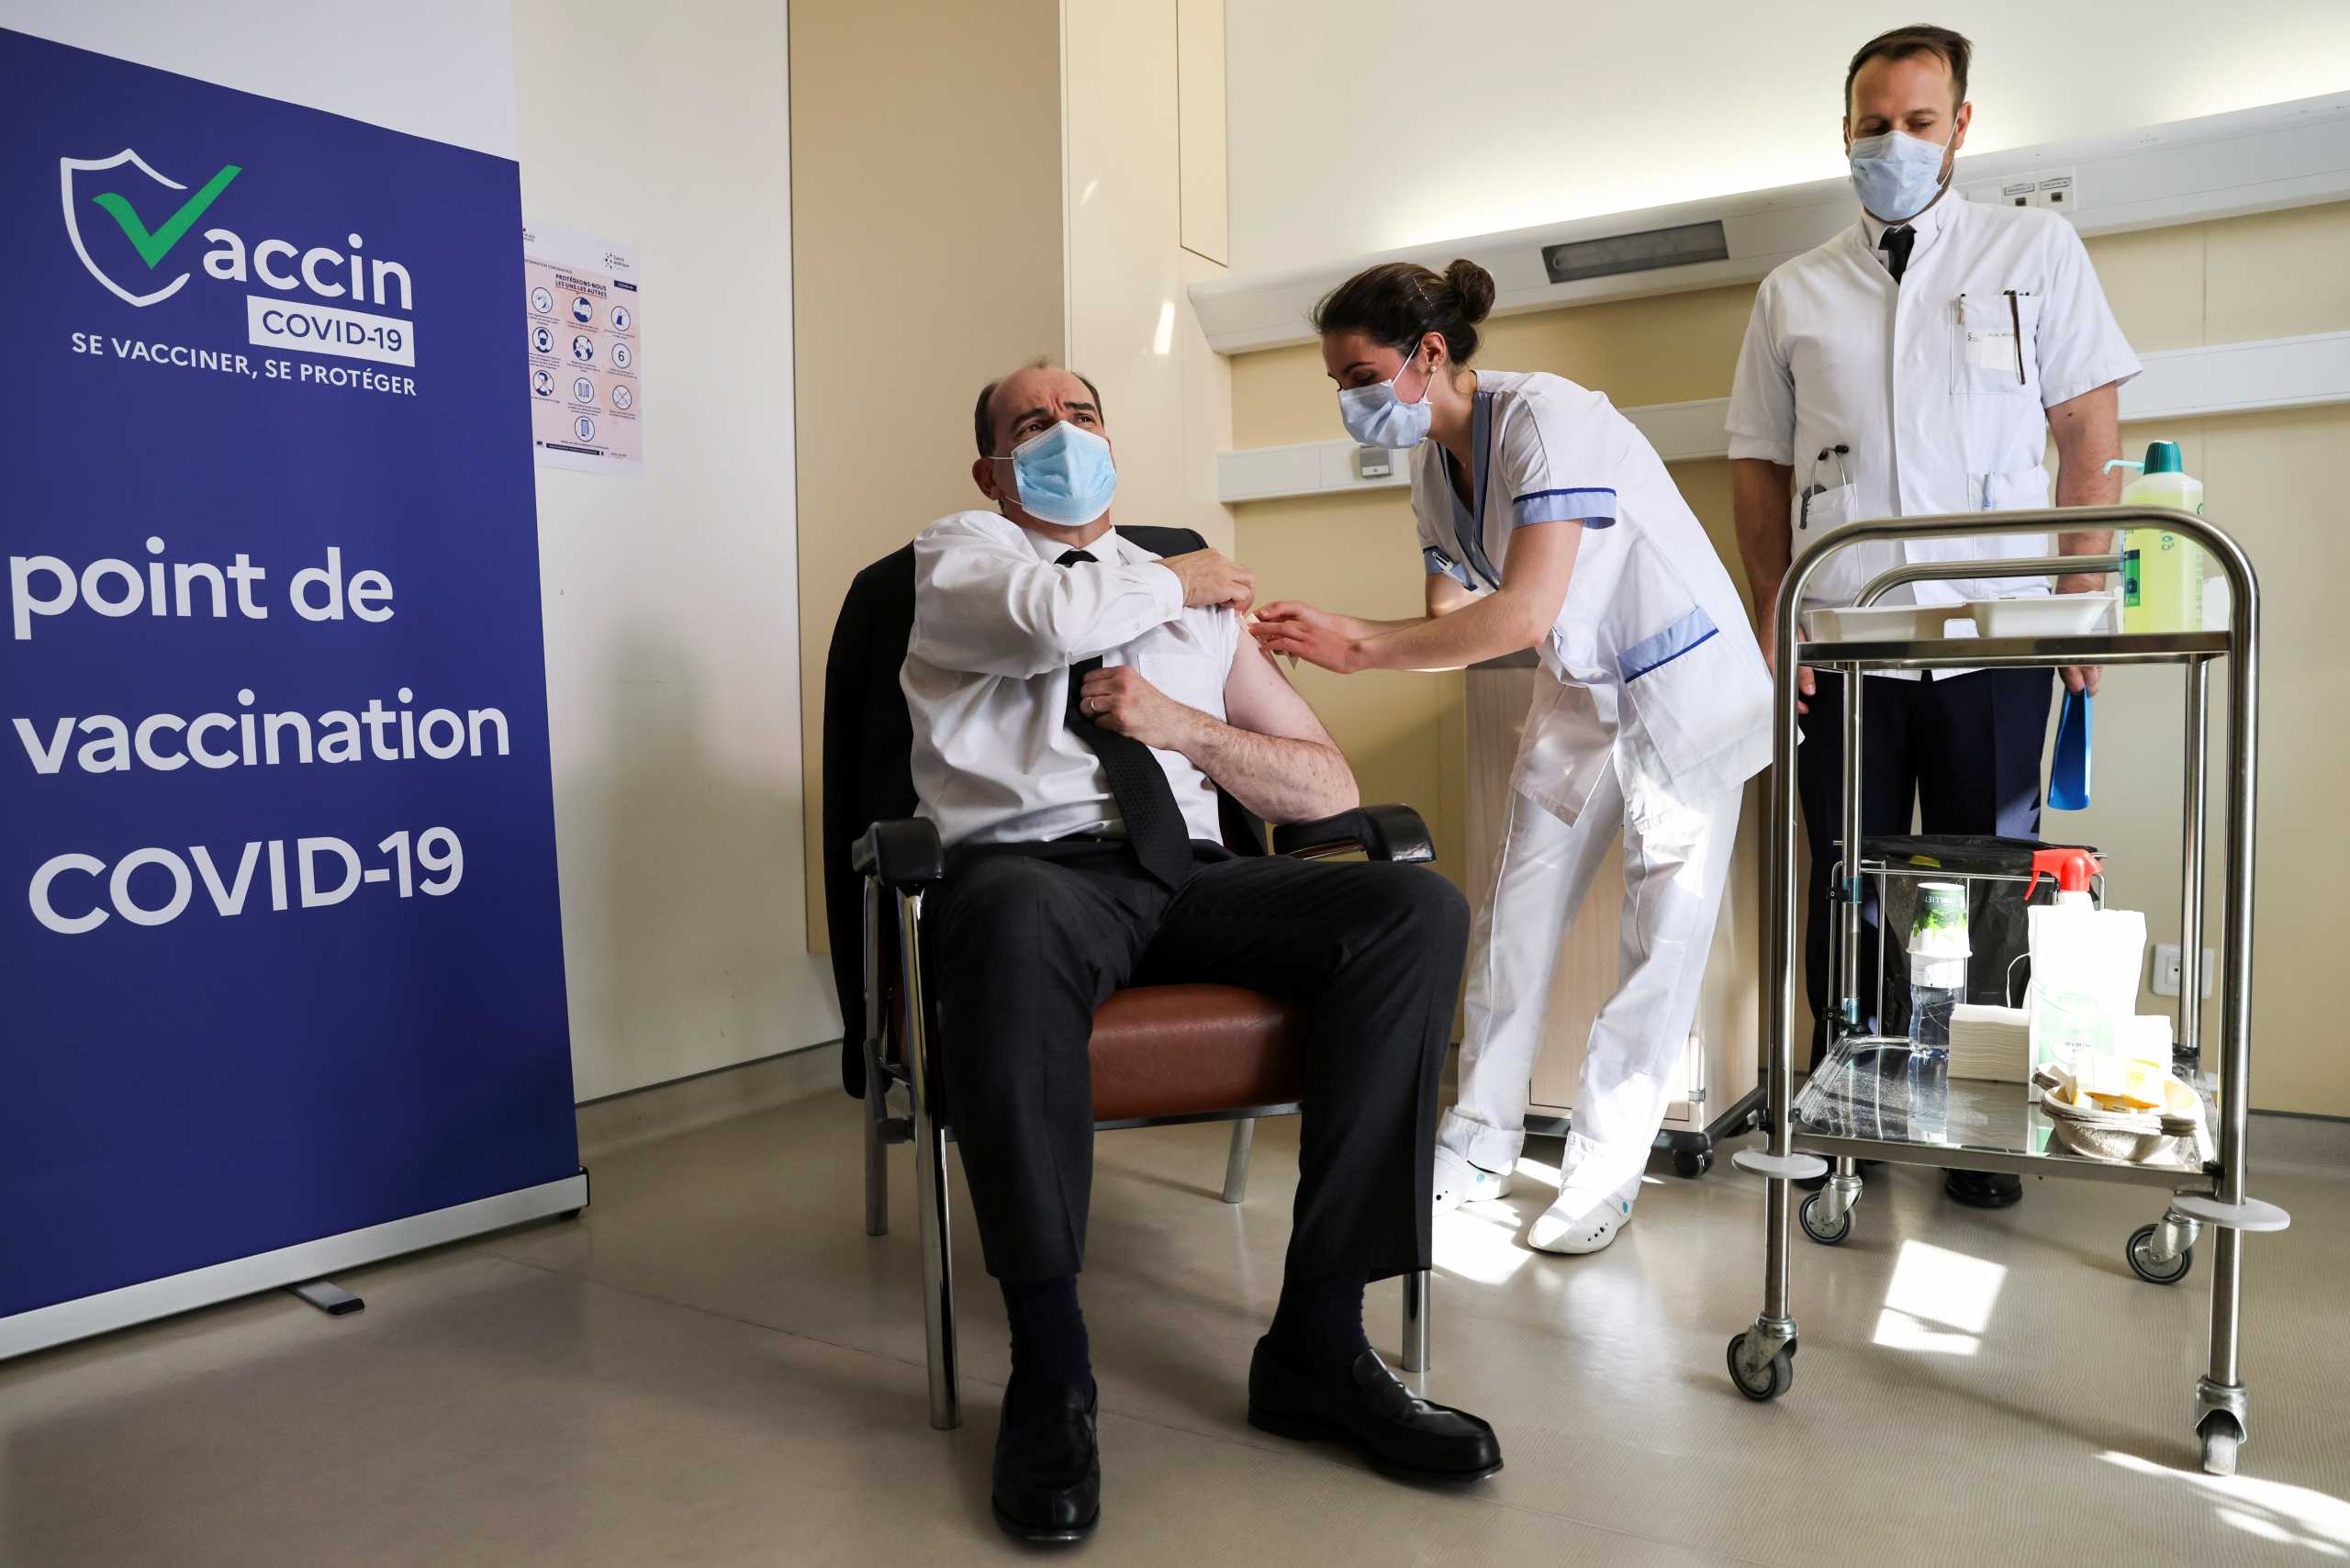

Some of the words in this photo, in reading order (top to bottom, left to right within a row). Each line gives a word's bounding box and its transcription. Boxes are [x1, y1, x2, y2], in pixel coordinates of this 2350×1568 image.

[72, 333, 104, 356] SE
[111, 337, 258, 379] VACCINER,
[264, 359, 292, 381] SE
[300, 364, 417, 397] PROTÉGER
[263, 310, 402, 353] COVID-19
[10, 536, 267, 641] point
[289, 546, 395, 622] de
[12, 688, 510, 775] vaccination
[28, 826, 464, 935] COVID-19
